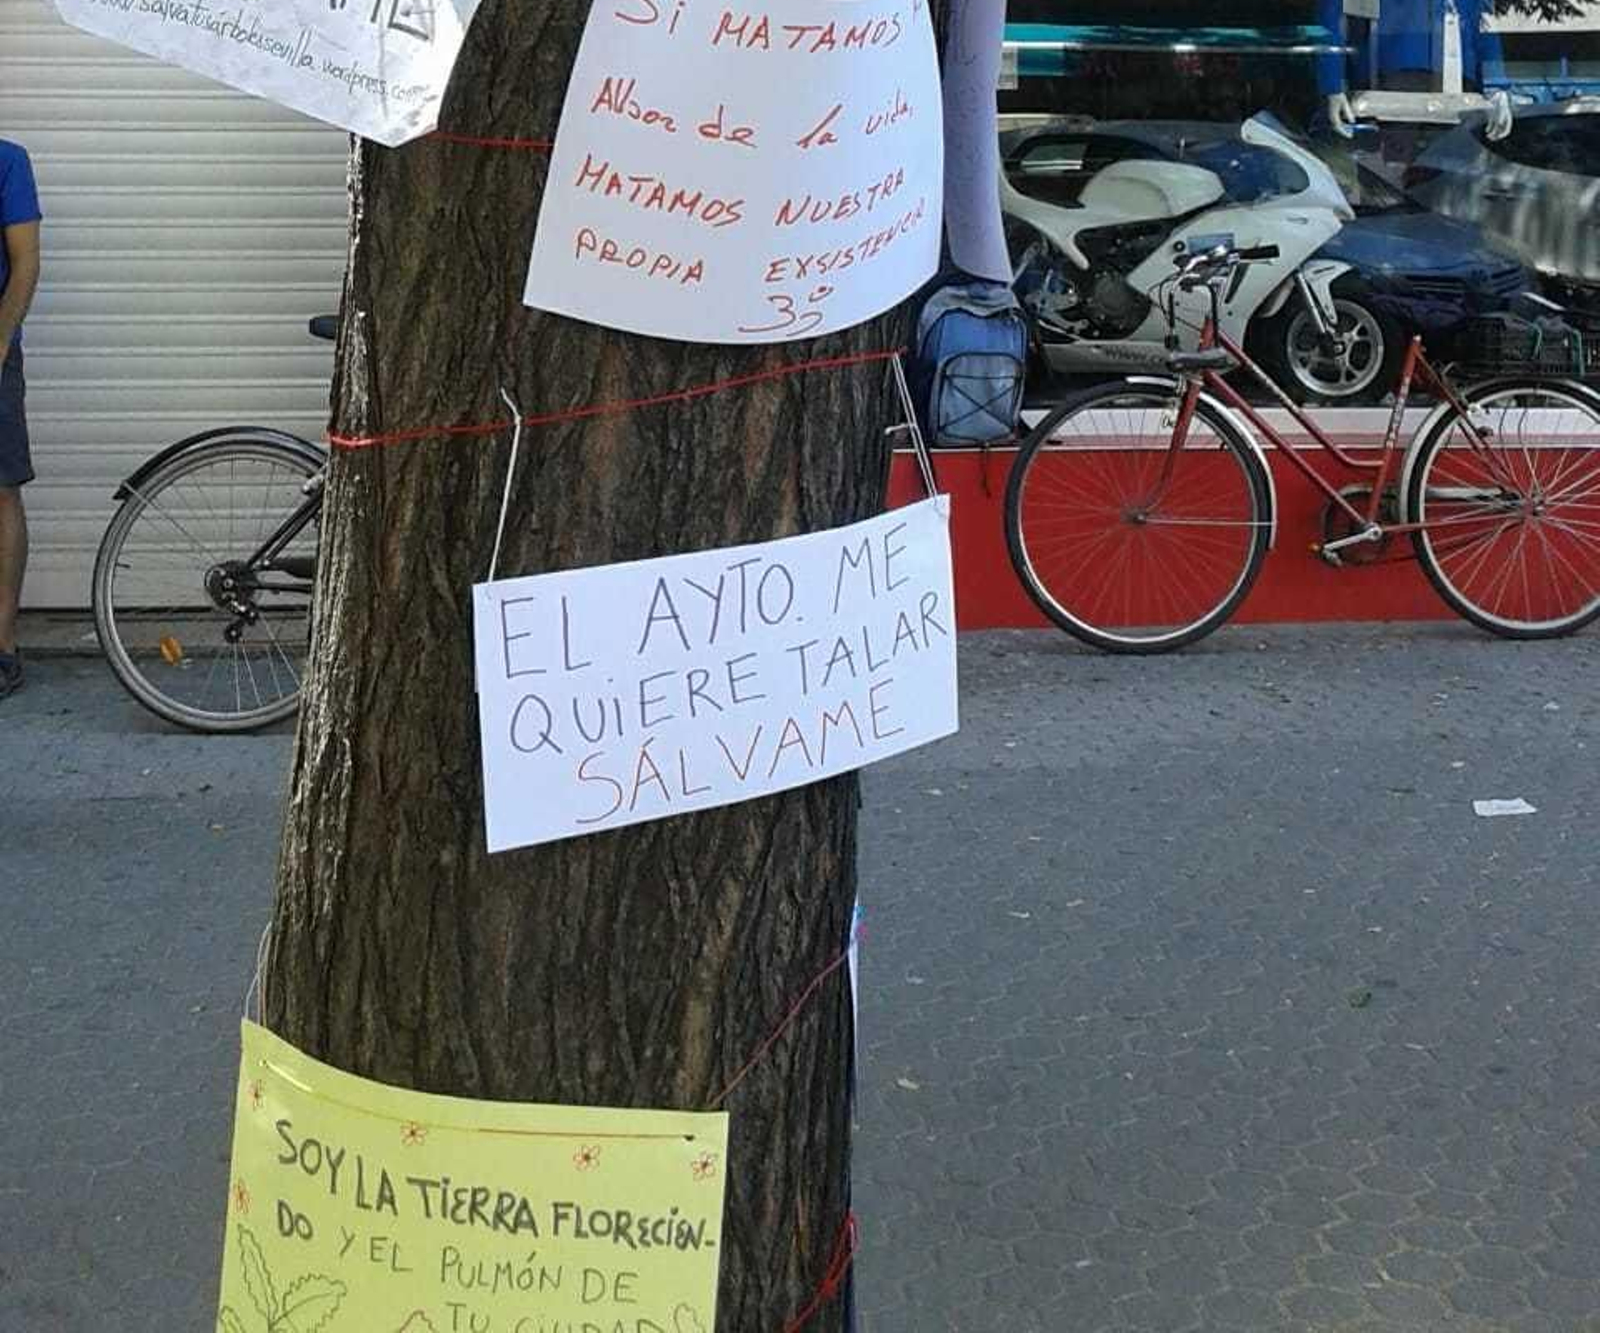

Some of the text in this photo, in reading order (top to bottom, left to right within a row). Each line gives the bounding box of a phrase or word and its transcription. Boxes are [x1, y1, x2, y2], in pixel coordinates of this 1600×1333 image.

[712, 10, 901, 54] MATAMOS
[699, 104, 757, 149] de
[575, 153, 905, 228] MATAMOS NUESTRA
[575, 227, 704, 284] PROPIA
[500, 595, 592, 680] EL
[834, 522, 912, 614] ME
[787, 591, 948, 695] TALAR
[575, 678, 906, 824] SÁLVAME
[276, 1119, 346, 1195] SOY
[356, 1154, 399, 1217] LA
[339, 1225, 356, 1258] Y
[370, 1236, 414, 1272] EL
[441, 1245, 563, 1296] PULMÓN
[581, 1268, 640, 1304] DE
[447, 1303, 491, 1333] TU
